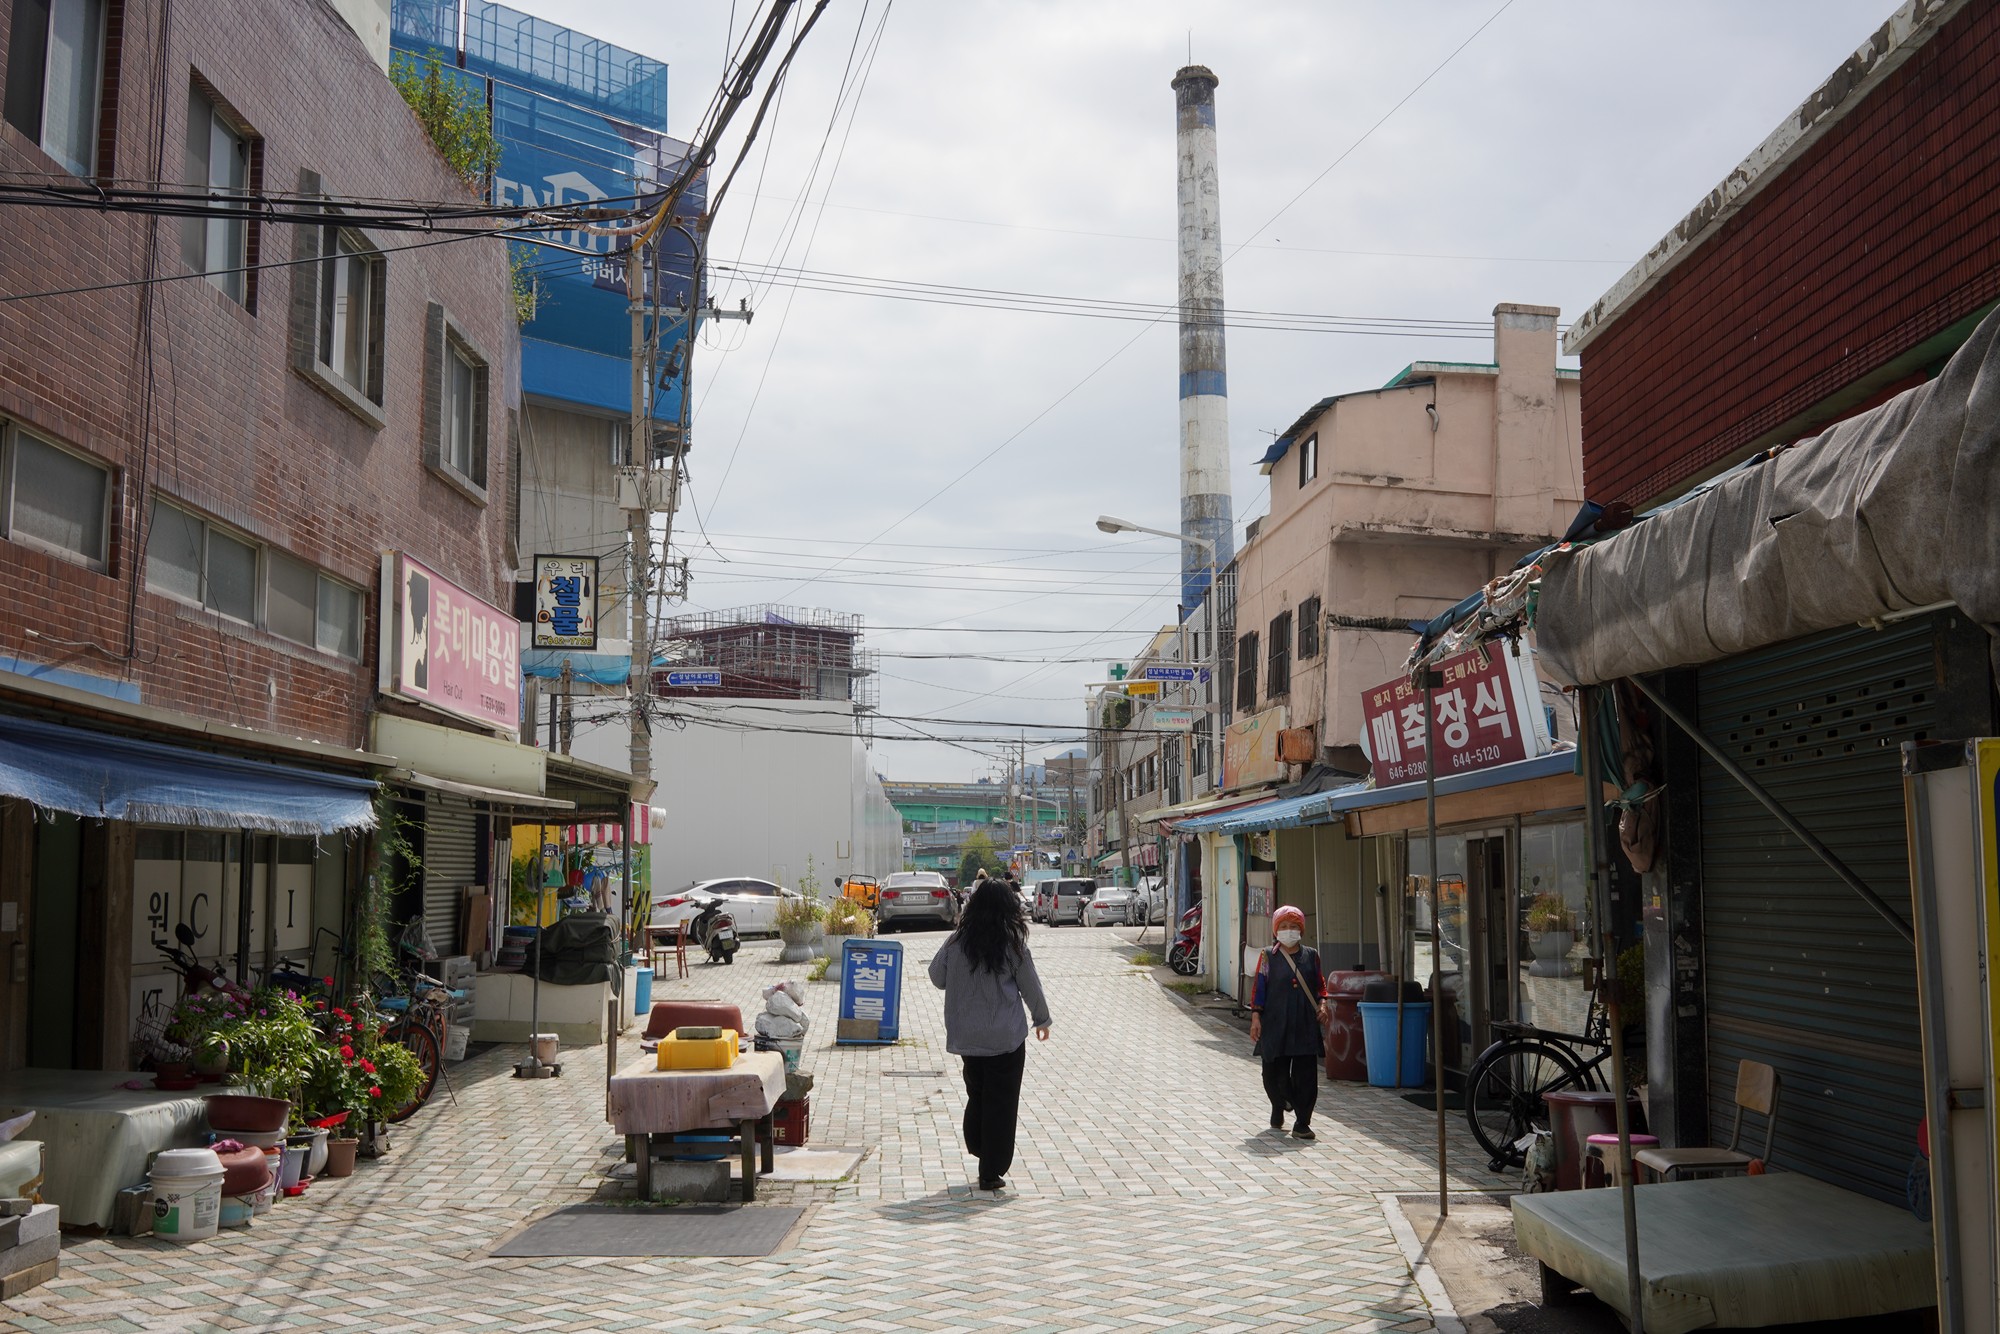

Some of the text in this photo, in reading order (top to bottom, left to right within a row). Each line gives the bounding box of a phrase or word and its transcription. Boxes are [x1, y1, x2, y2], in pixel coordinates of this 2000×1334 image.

[580, 256, 648, 293] 하버시
[544, 560, 588, 577] 우리
[549, 576, 583, 636] 철물
[433, 589, 516, 691] 롯데미용실
[443, 679, 463, 701] Hair Cut
[1373, 690, 1391, 708] 엘지
[1371, 675, 1513, 764] 매축장식
[1452, 744, 1501, 768] 644-5120
[148, 892, 169, 946] 원
[850, 952, 893, 967] 우리
[853, 967, 886, 1021] 철물
